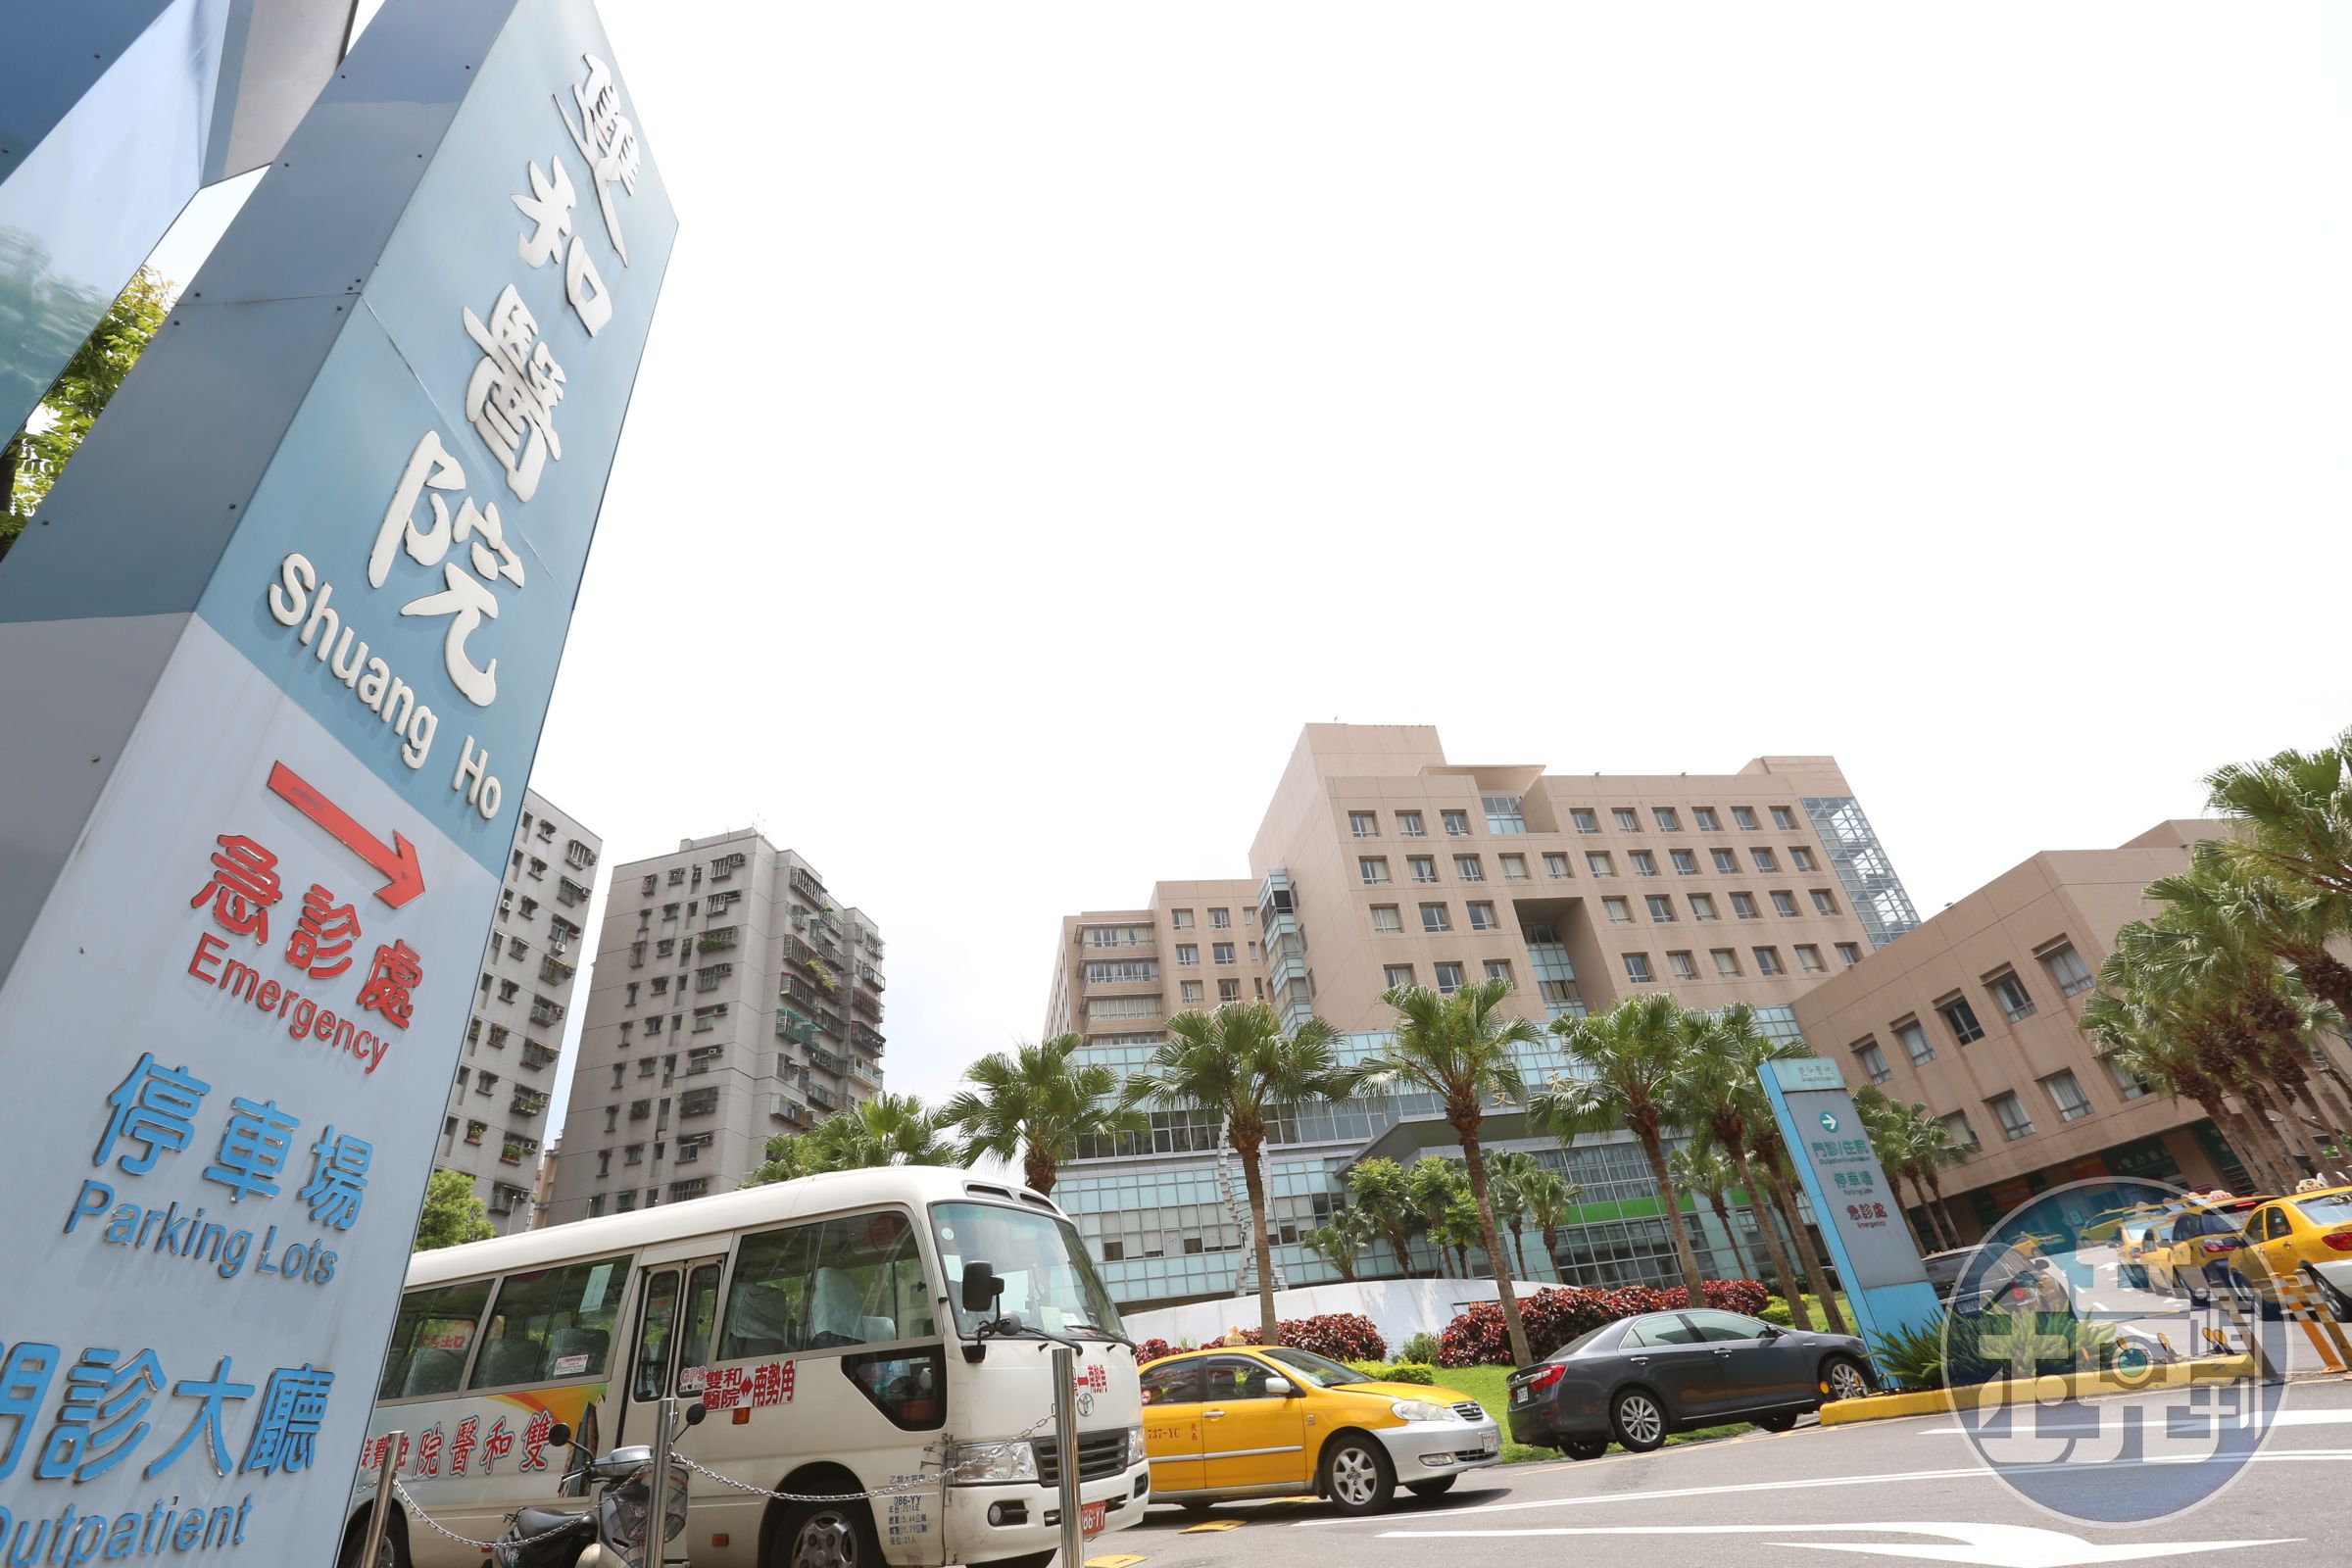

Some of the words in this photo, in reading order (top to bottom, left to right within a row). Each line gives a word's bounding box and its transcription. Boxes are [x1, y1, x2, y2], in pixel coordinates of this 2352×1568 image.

[269, 552, 438, 768] Shuang
[452, 735, 502, 820] Ho
[192, 834, 425, 1032] 急診處
[188, 932, 390, 1075] Emergency
[92, 1053, 374, 1231] 停車場
[1834, 1170, 1874, 1188] 停車場
[64, 1179, 255, 1280] Parking
[256, 1224, 340, 1286] Lots
[1846, 1201, 1888, 1221] 急診處
[681, 1367, 706, 1383] GPS
[753, 1360, 795, 1407] 南勢角
[0, 1493, 253, 1568] utpatient
[1082, 1506, 1106, 1530] 86-YY
